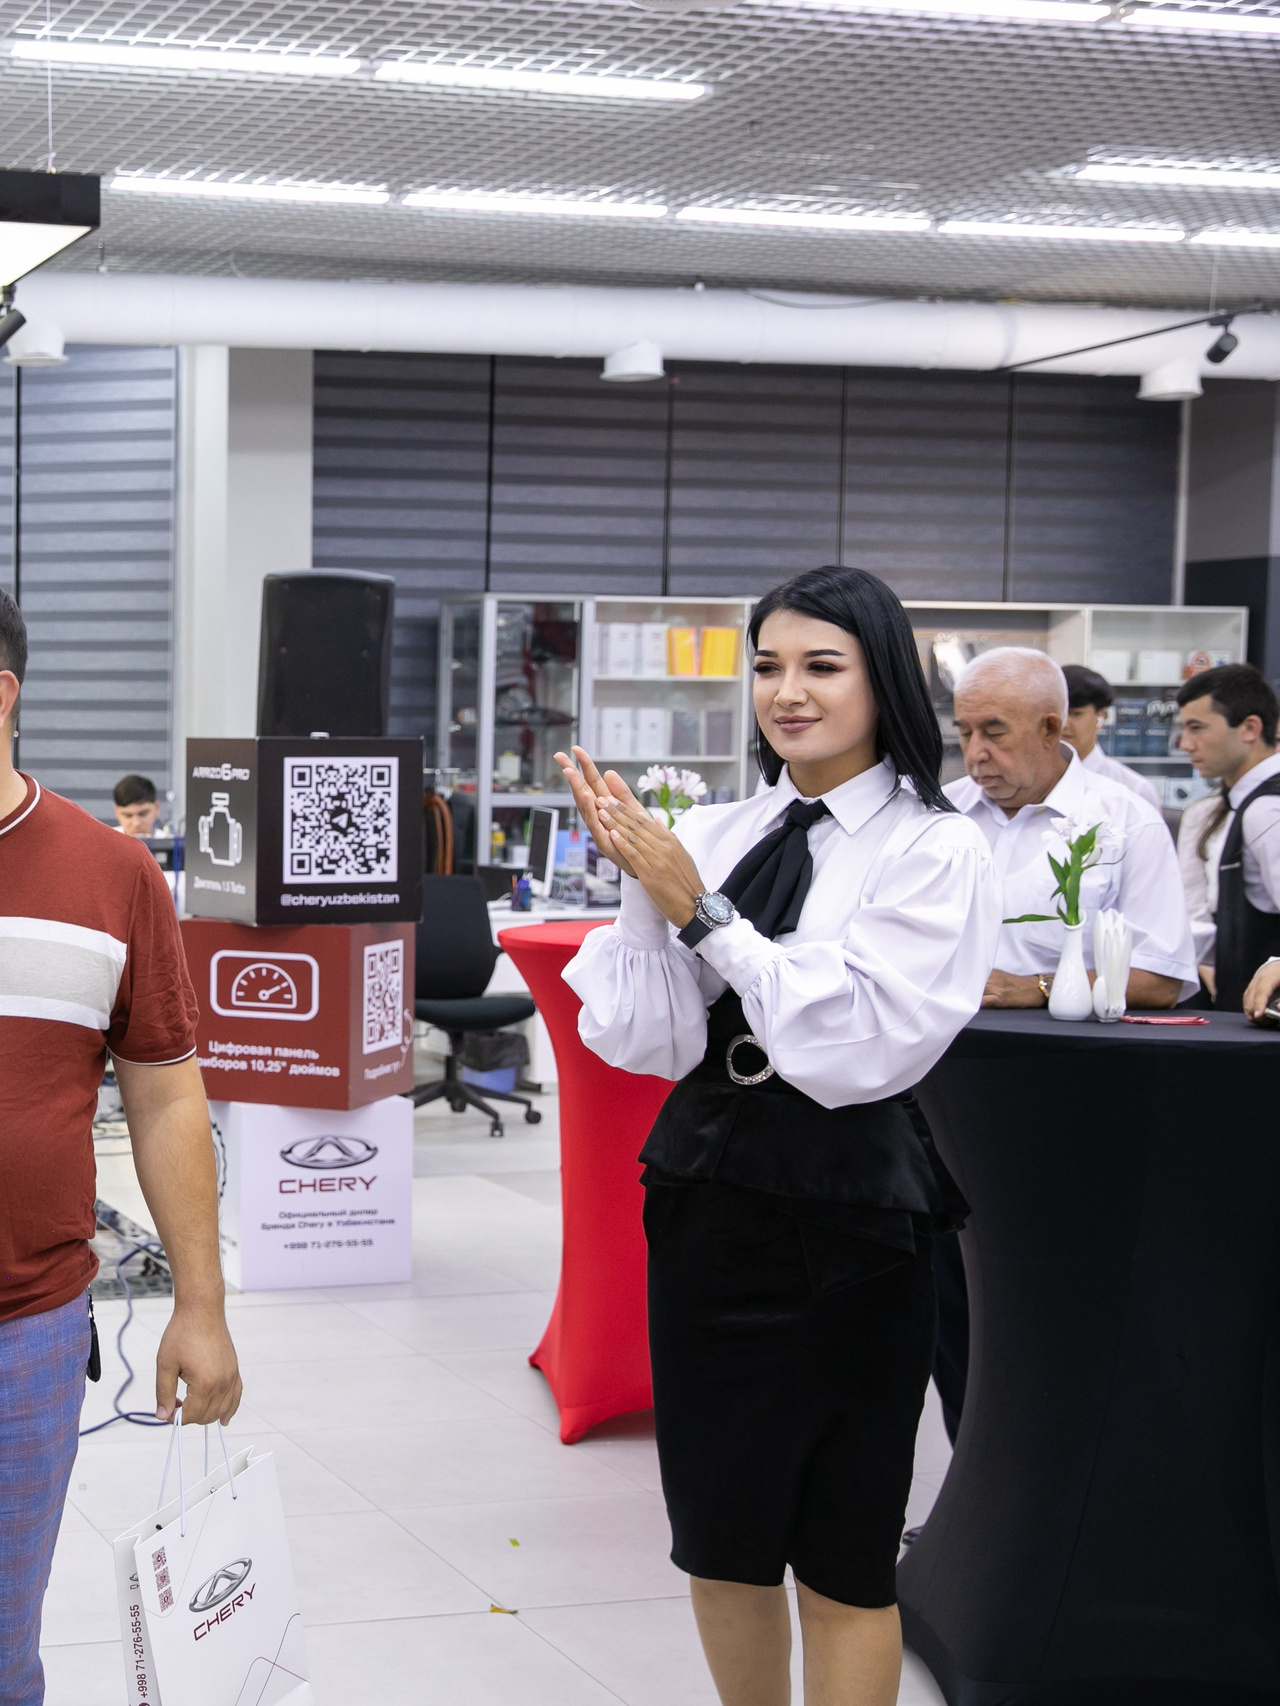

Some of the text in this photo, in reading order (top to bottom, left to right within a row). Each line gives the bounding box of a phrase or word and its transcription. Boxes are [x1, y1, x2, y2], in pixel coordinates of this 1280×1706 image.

[280, 893, 400, 906] @cheryuzbekistan
[208, 1040, 320, 1060] Цифровая панель
[196, 1057, 248, 1072] риборов
[289, 1063, 340, 1077] дюймов
[279, 1176, 377, 1194] CHERY
[193, 1583, 256, 1641] CHERY
[129, 1604, 145, 1671] 71-276-55-55
[136, 1673, 148, 1698] +998
